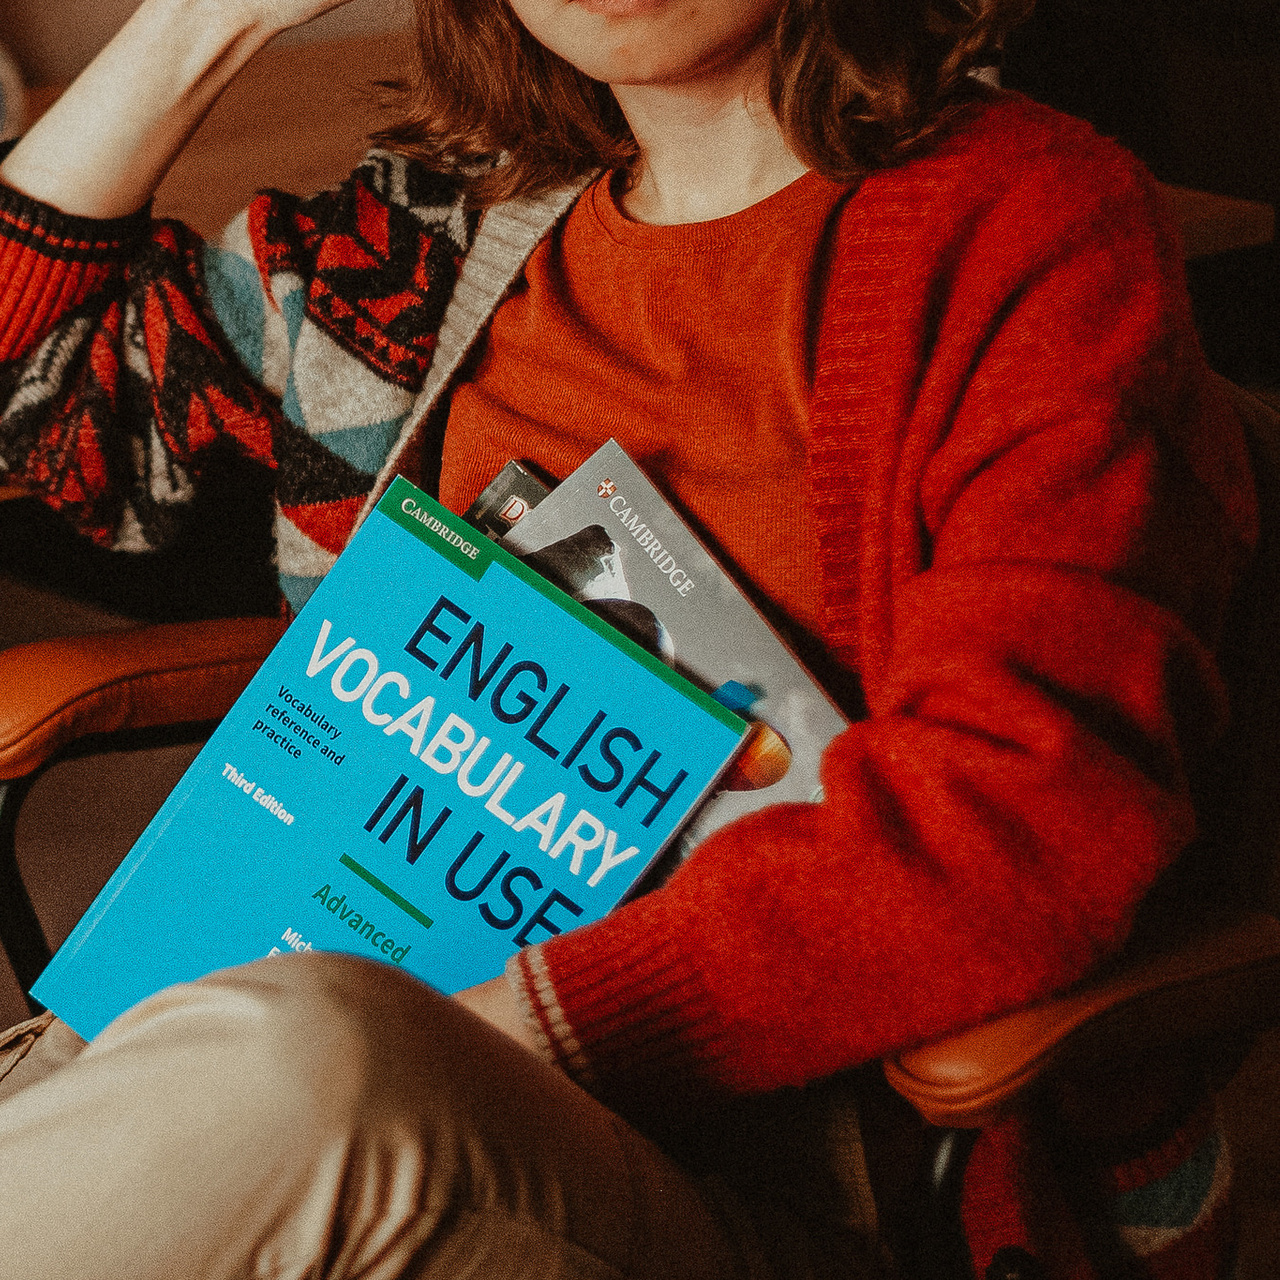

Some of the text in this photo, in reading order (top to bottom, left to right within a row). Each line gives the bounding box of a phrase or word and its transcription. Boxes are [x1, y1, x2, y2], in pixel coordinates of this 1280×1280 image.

[401, 497, 480, 560] CAMBRIDGE
[609, 495, 696, 597] CAMBRIDGE
[251, 719, 302, 759] practice
[265, 703, 346, 766] reference and
[277, 685, 342, 740] Vocabulary
[403, 594, 689, 829] ENGLISH
[305, 619, 640, 888] VOCABULARY
[221, 762, 295, 826] Third Edition
[363, 773, 585, 948] IN USE
[311, 883, 412, 964] Advanced
